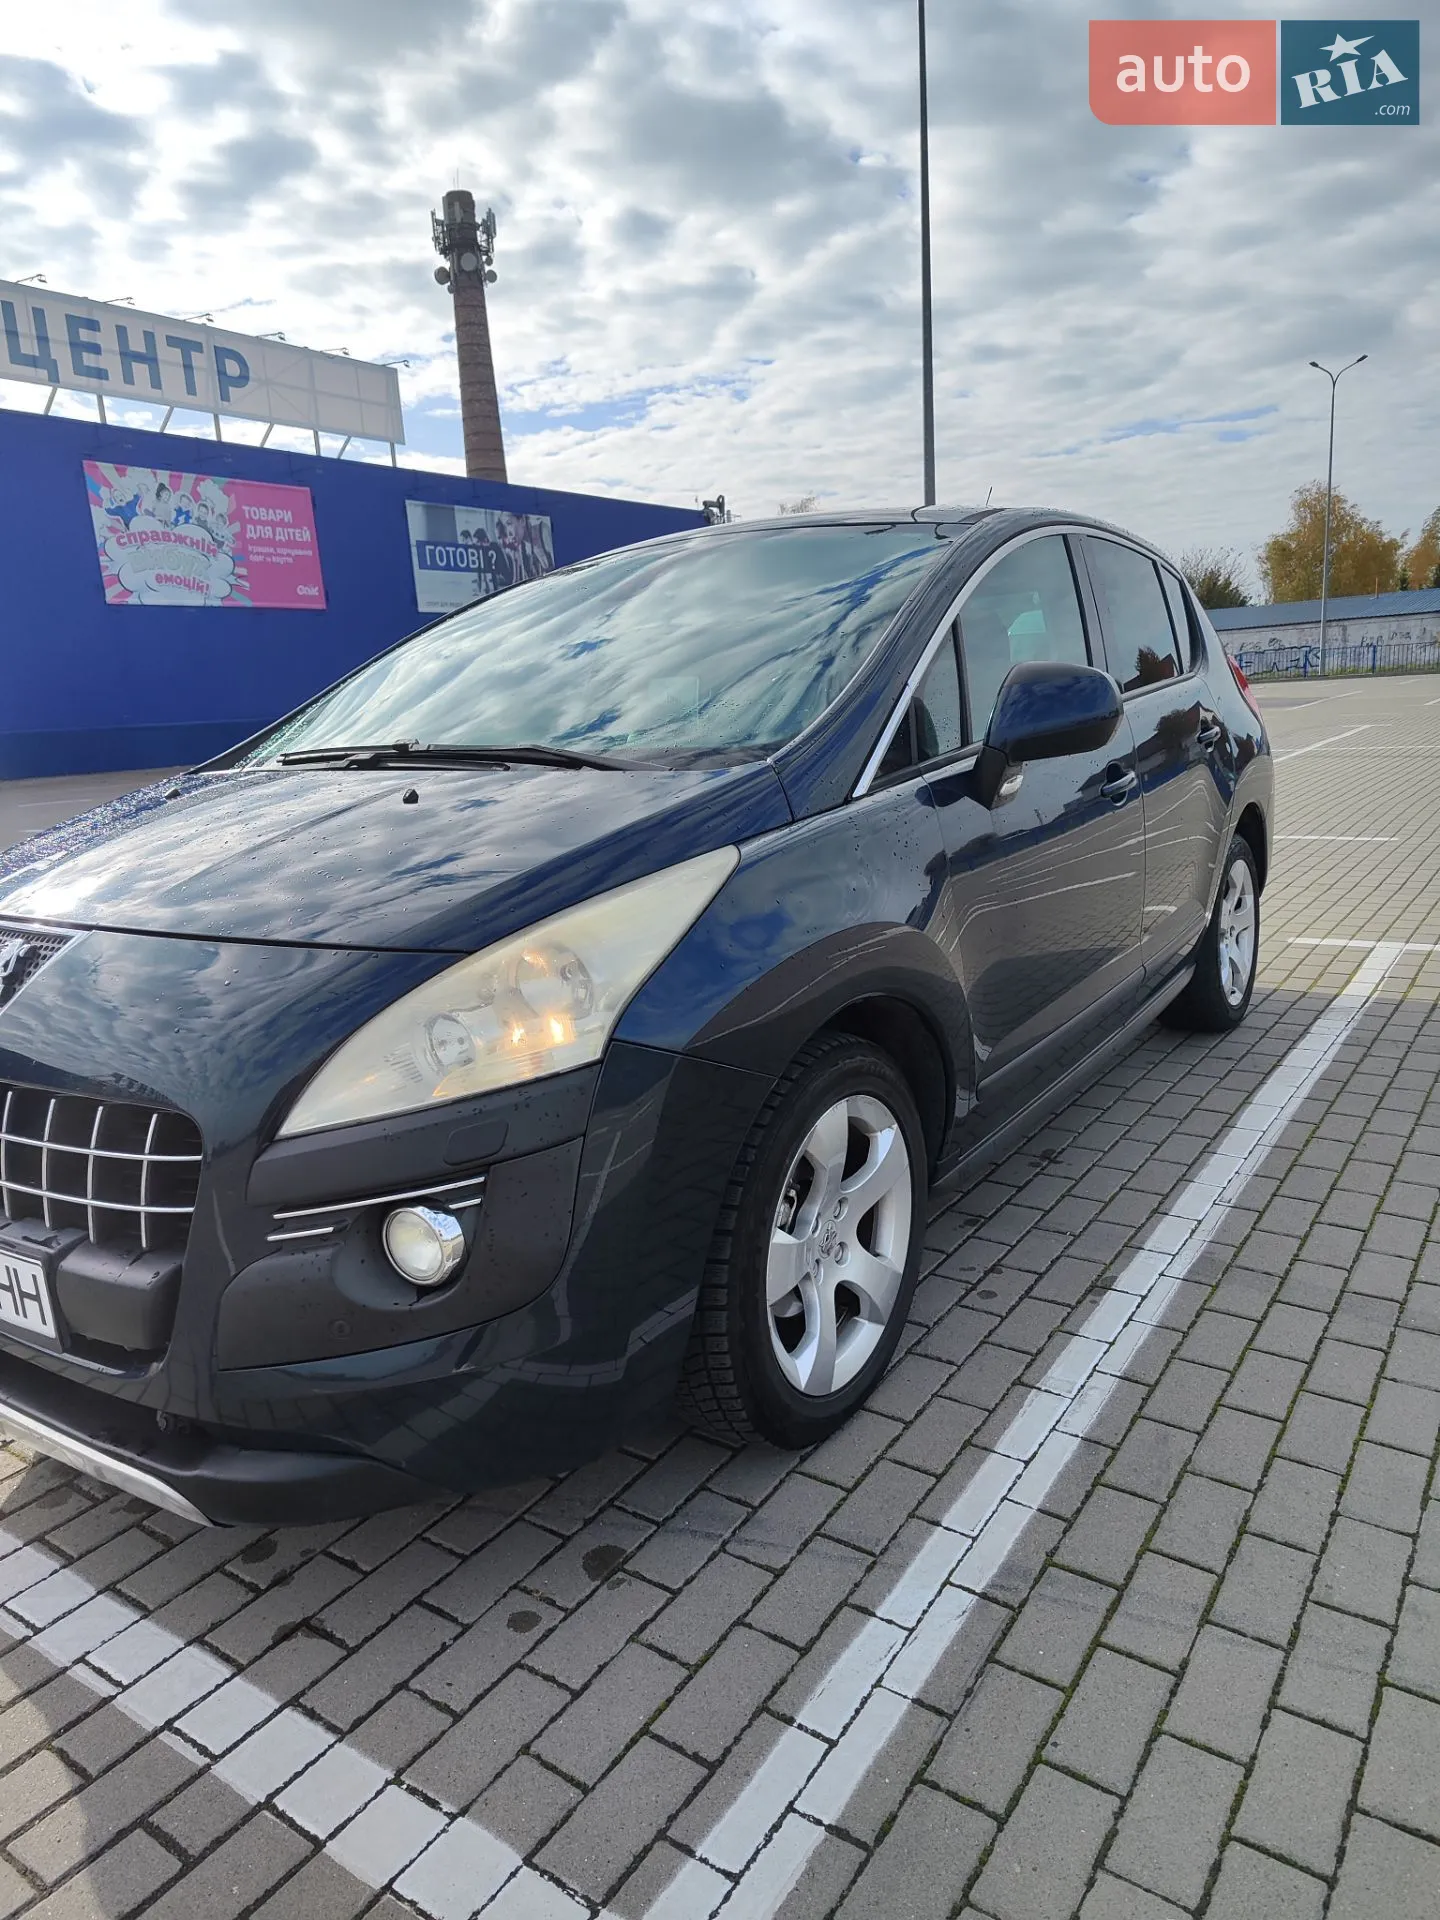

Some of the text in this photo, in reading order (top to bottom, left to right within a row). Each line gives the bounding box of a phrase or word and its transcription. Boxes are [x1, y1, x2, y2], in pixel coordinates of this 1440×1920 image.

[1, 301, 251, 402] ЦЕНТР
[241, 505, 293, 523] ТОВАРИ
[246, 524, 312, 543] ДЛЯ ДІТЕЙ
[425, 545, 484, 569] ГОТОВІ
